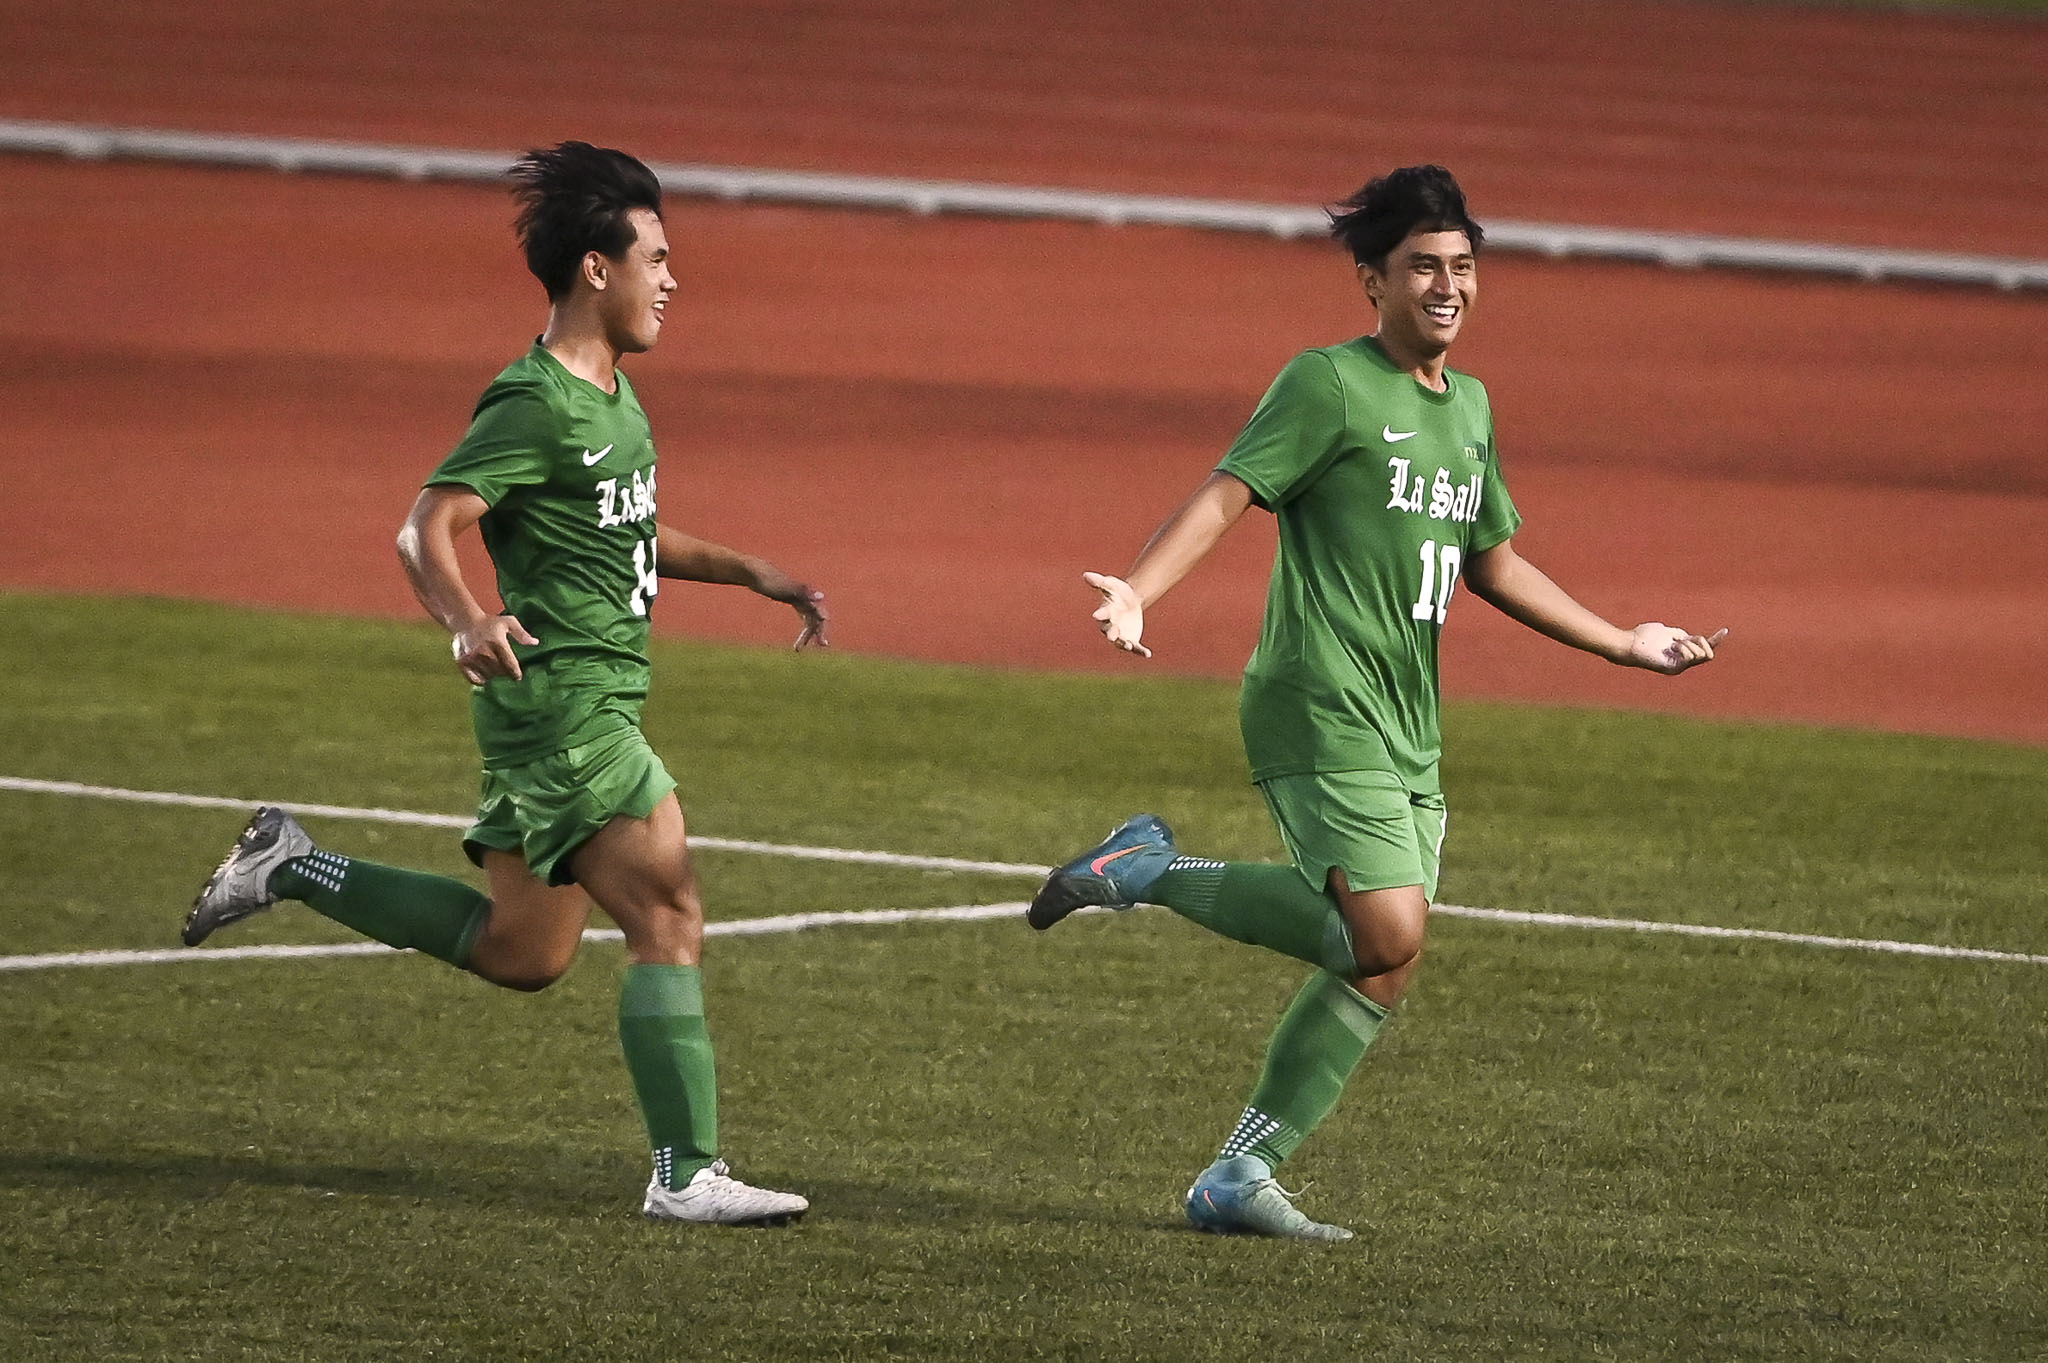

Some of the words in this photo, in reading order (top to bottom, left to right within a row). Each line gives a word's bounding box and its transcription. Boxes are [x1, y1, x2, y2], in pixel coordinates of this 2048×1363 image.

[595, 478, 637, 528] La
[1386, 456, 1426, 514] La
[1428, 466, 1484, 523] Sall
[1411, 539, 1461, 625] 10
